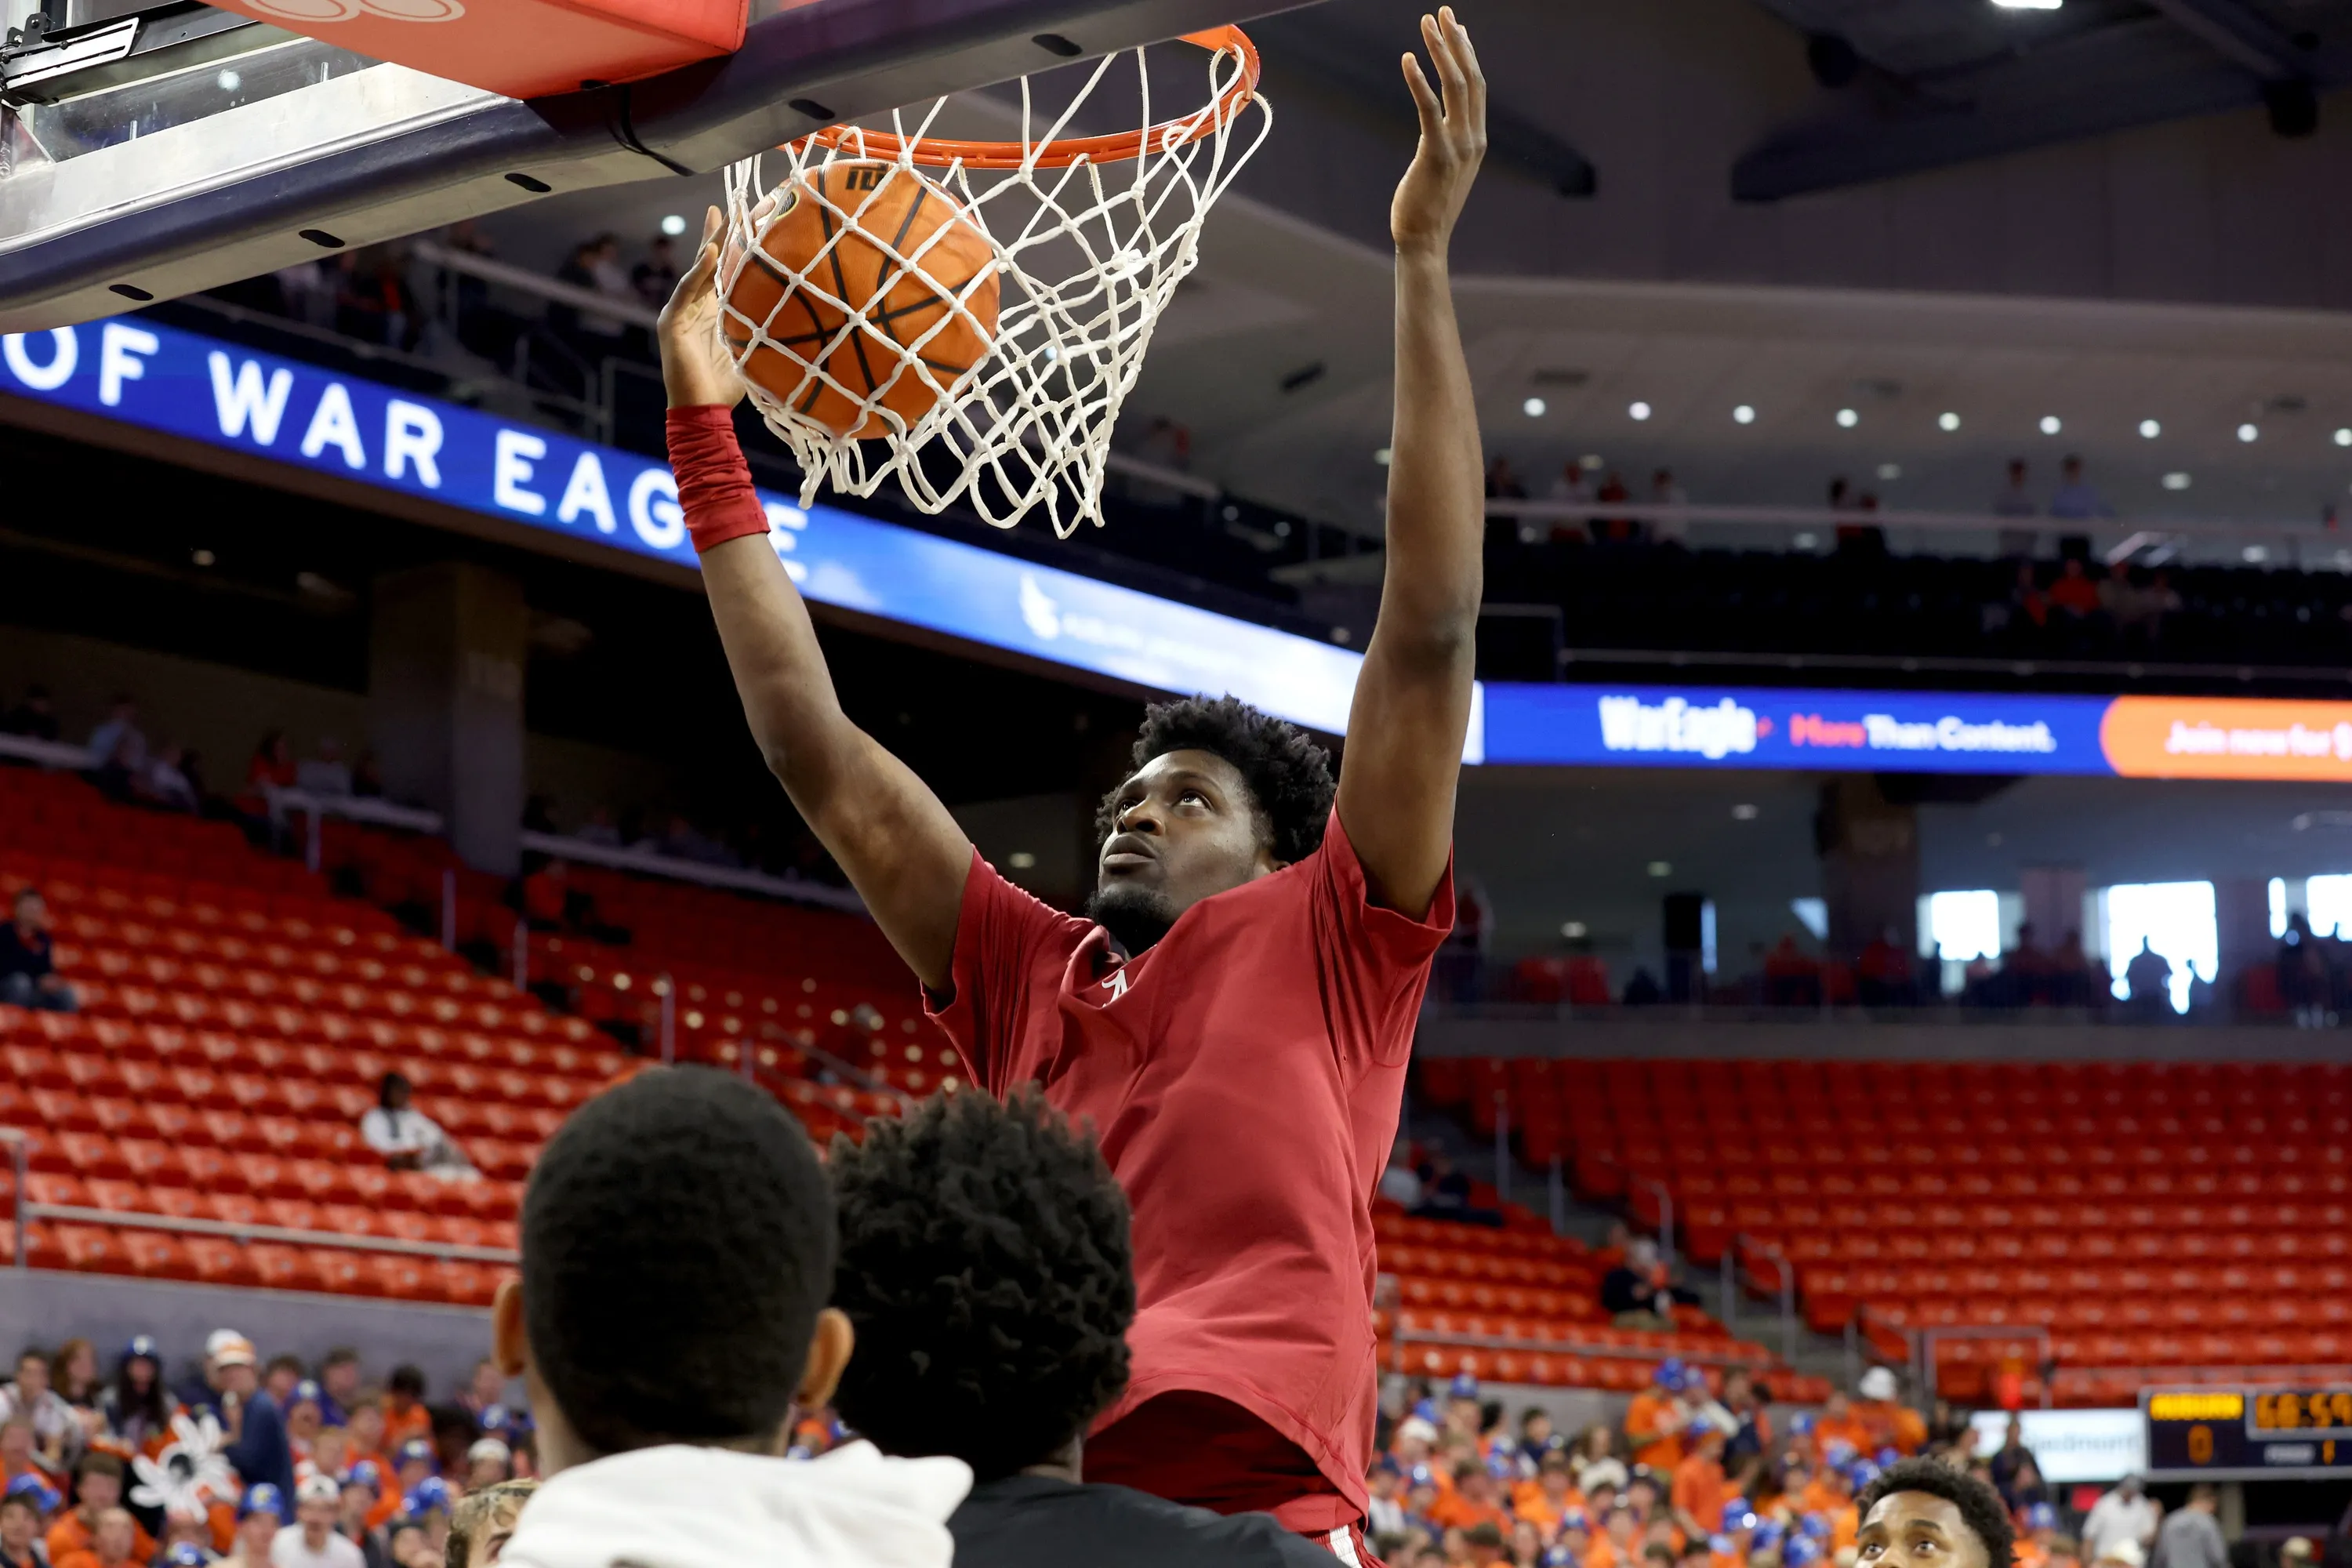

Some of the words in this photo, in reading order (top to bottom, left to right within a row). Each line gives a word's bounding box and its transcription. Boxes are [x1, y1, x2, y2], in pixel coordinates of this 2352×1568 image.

[2, 322, 159, 407] OF
[208, 350, 443, 488] WAR
[494, 427, 808, 581] EAGE
[1790, 713, 1865, 747] More
[1862, 713, 1936, 750] Than
[2165, 719, 2227, 754] Join
[2228, 729, 2287, 756] now
[2288, 722, 2330, 757] for
